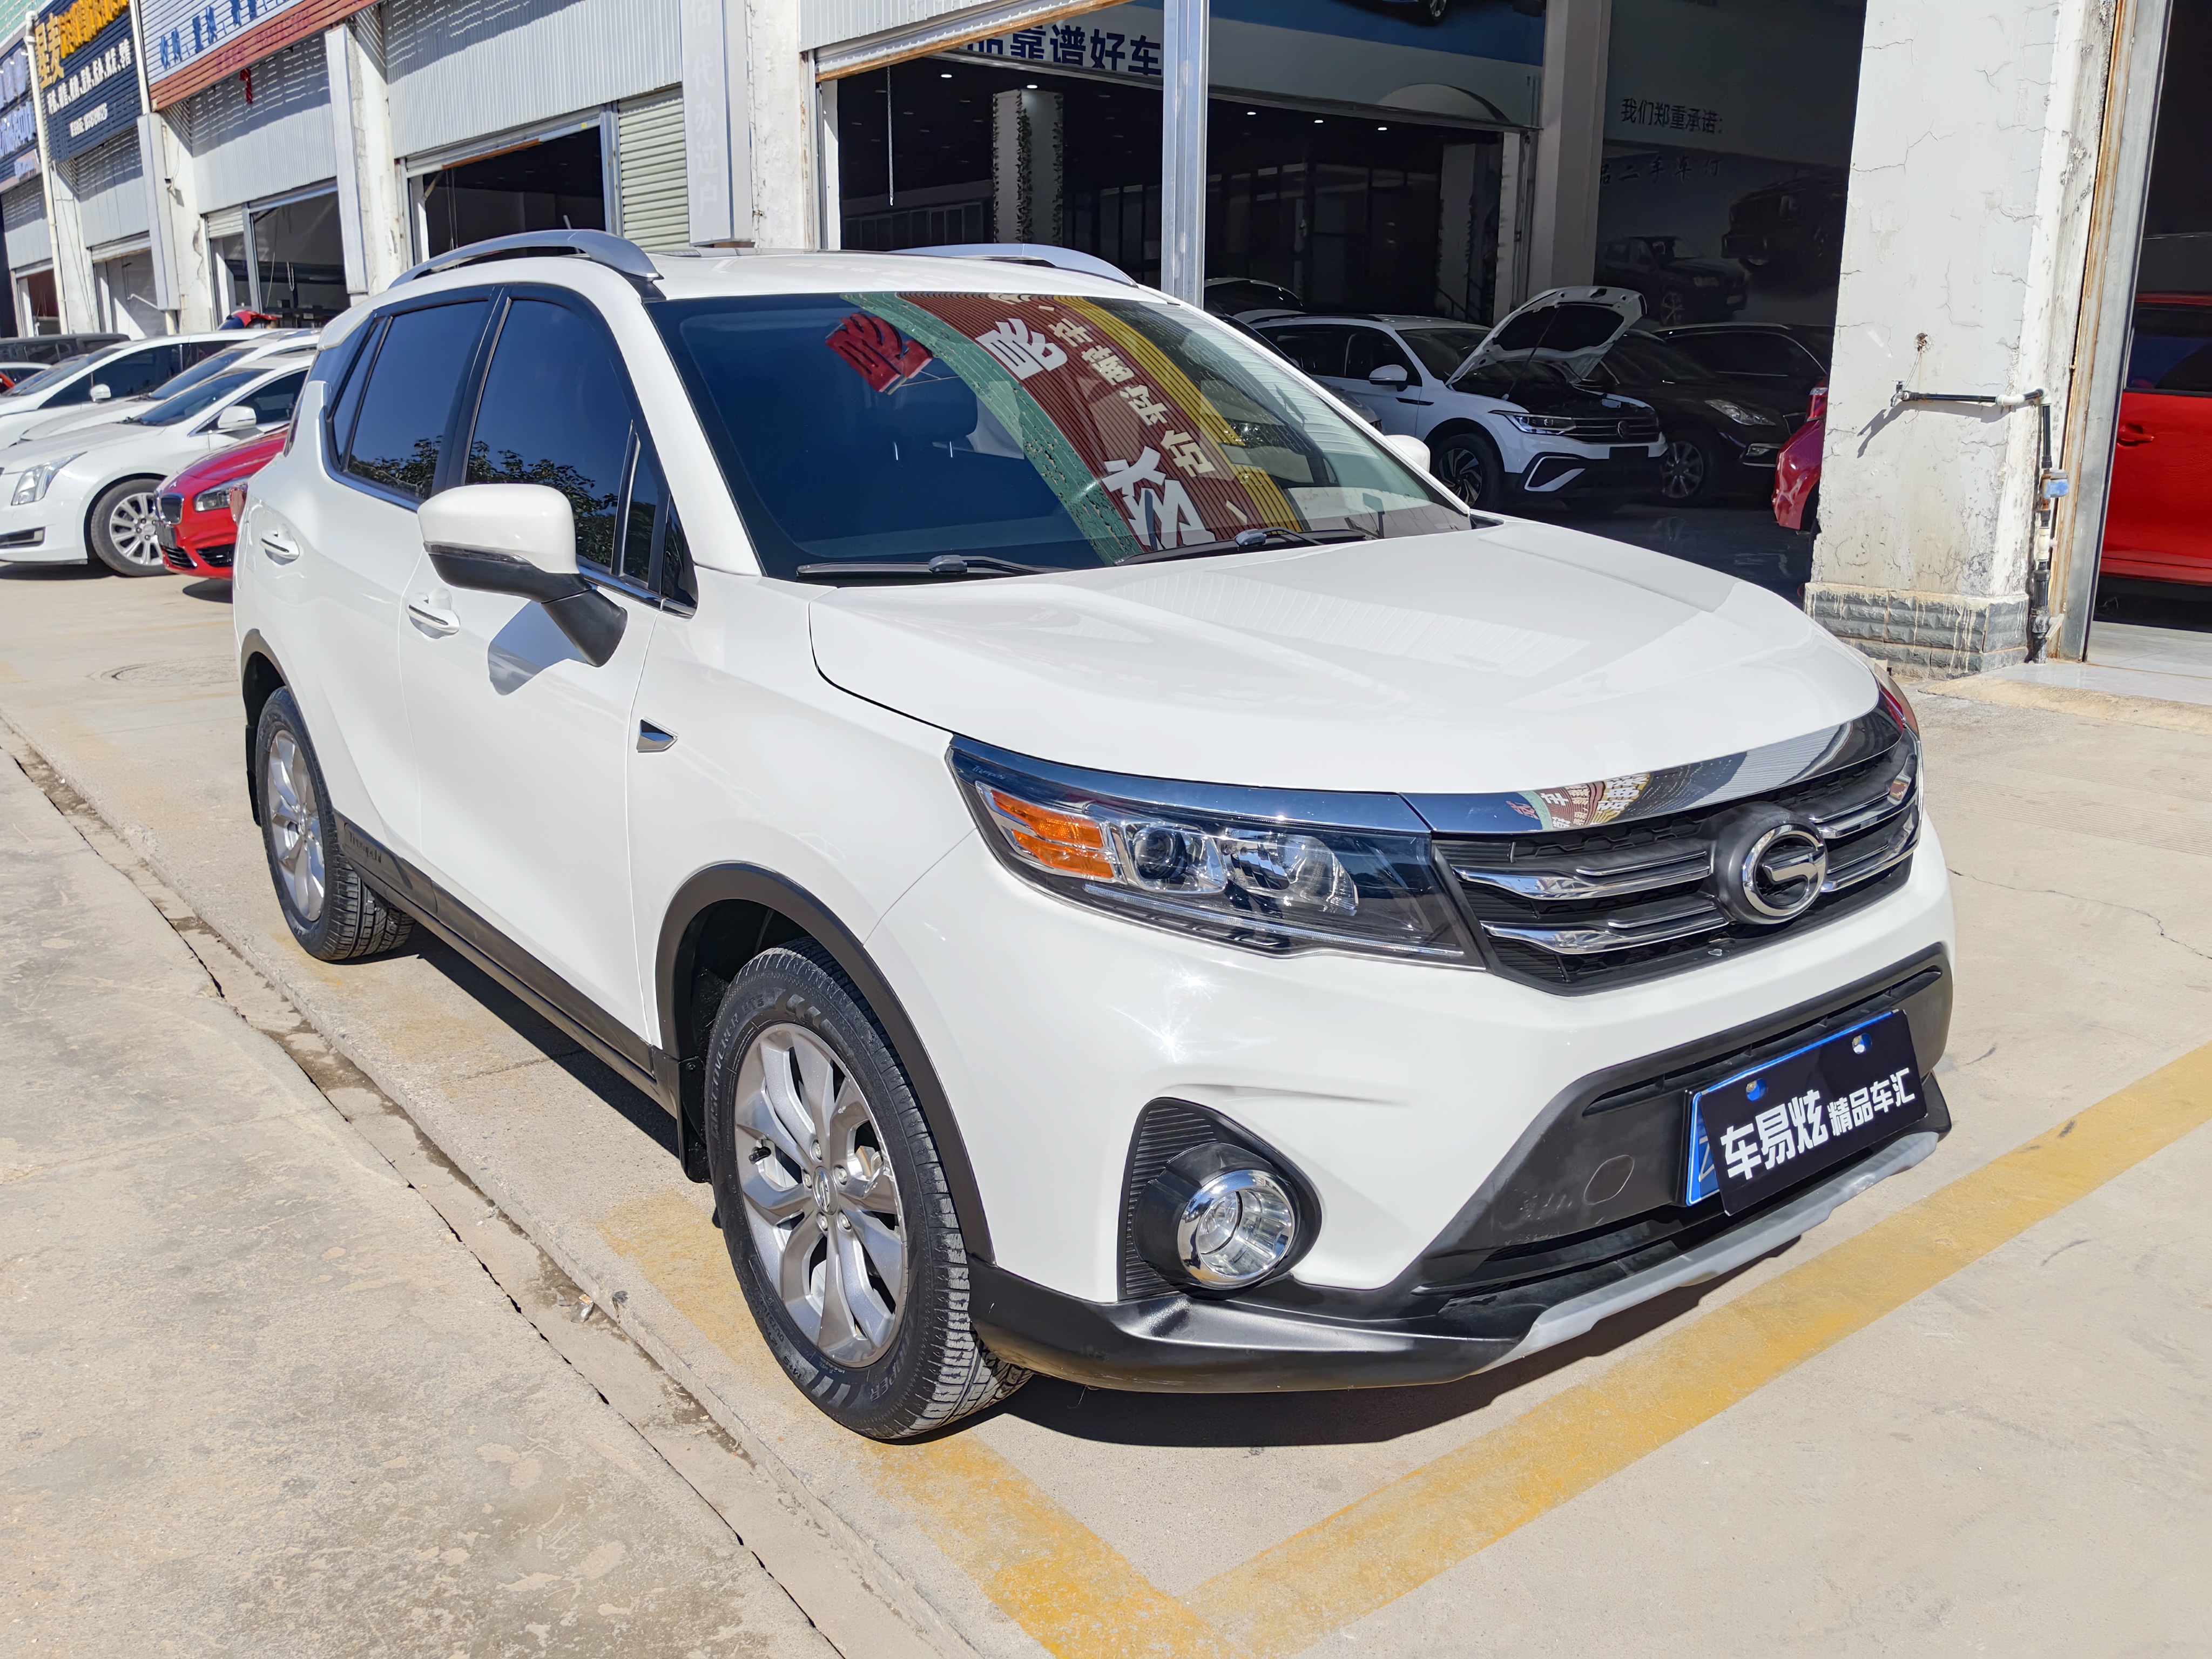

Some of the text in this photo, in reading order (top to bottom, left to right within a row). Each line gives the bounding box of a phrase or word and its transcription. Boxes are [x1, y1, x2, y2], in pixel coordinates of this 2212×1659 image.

[1721, 1089, 1829, 1180] 车易炫
[1827, 1068, 1916, 1136] 精品车汇
